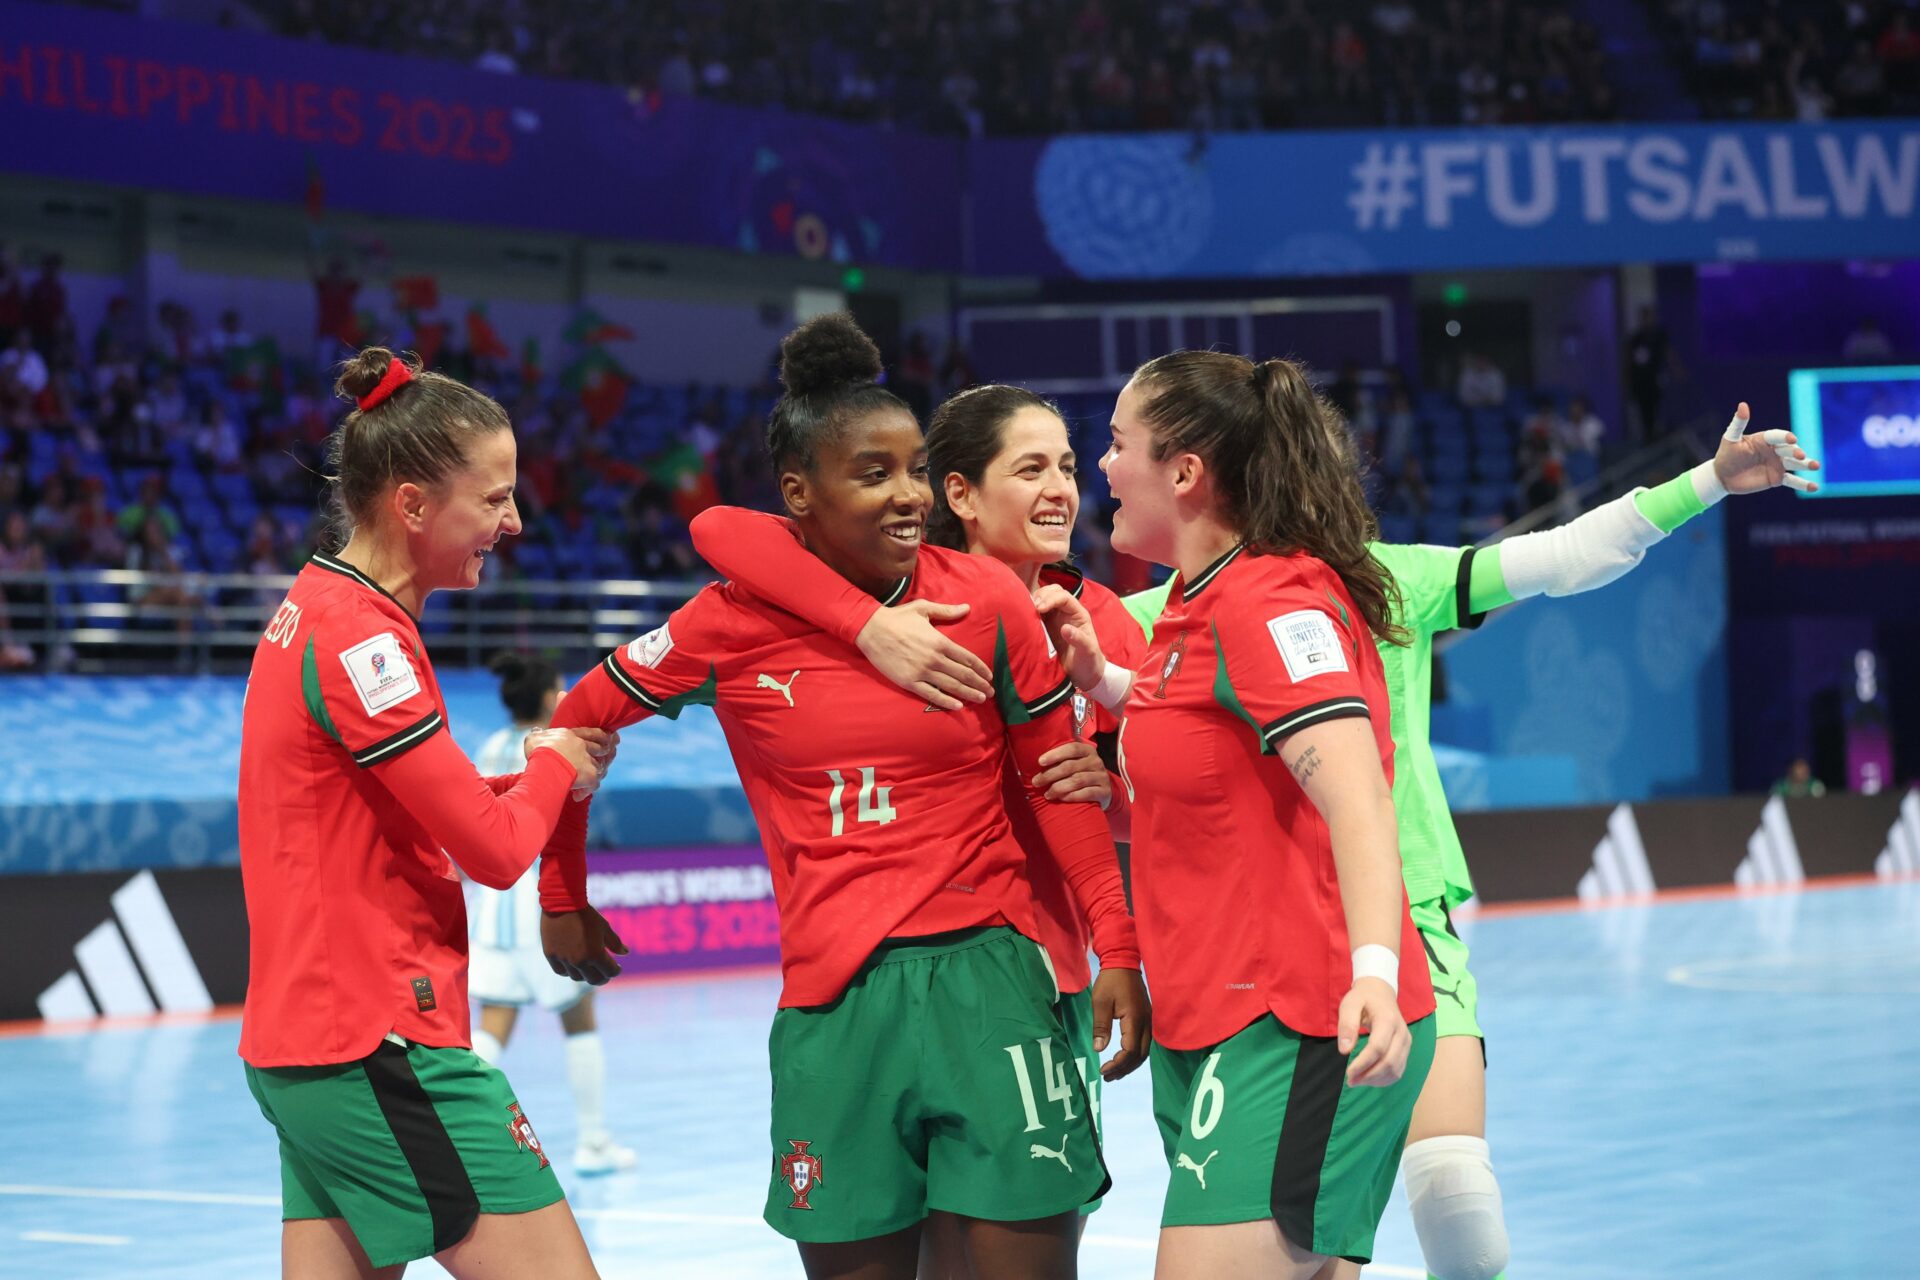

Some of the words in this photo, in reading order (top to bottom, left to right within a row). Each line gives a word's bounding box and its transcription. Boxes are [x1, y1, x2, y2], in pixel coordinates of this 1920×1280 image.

[377, 91, 514, 166] 2025
[264, 598, 303, 649] EDO
[1286, 620, 1321, 634] FOOTBALL
[1289, 628, 1326, 645] UNITES
[380, 675, 392, 684] FIFA
[824, 767, 897, 837] 14
[1003, 1036, 1077, 1132] 14
[1190, 1052, 1225, 1140] 6
